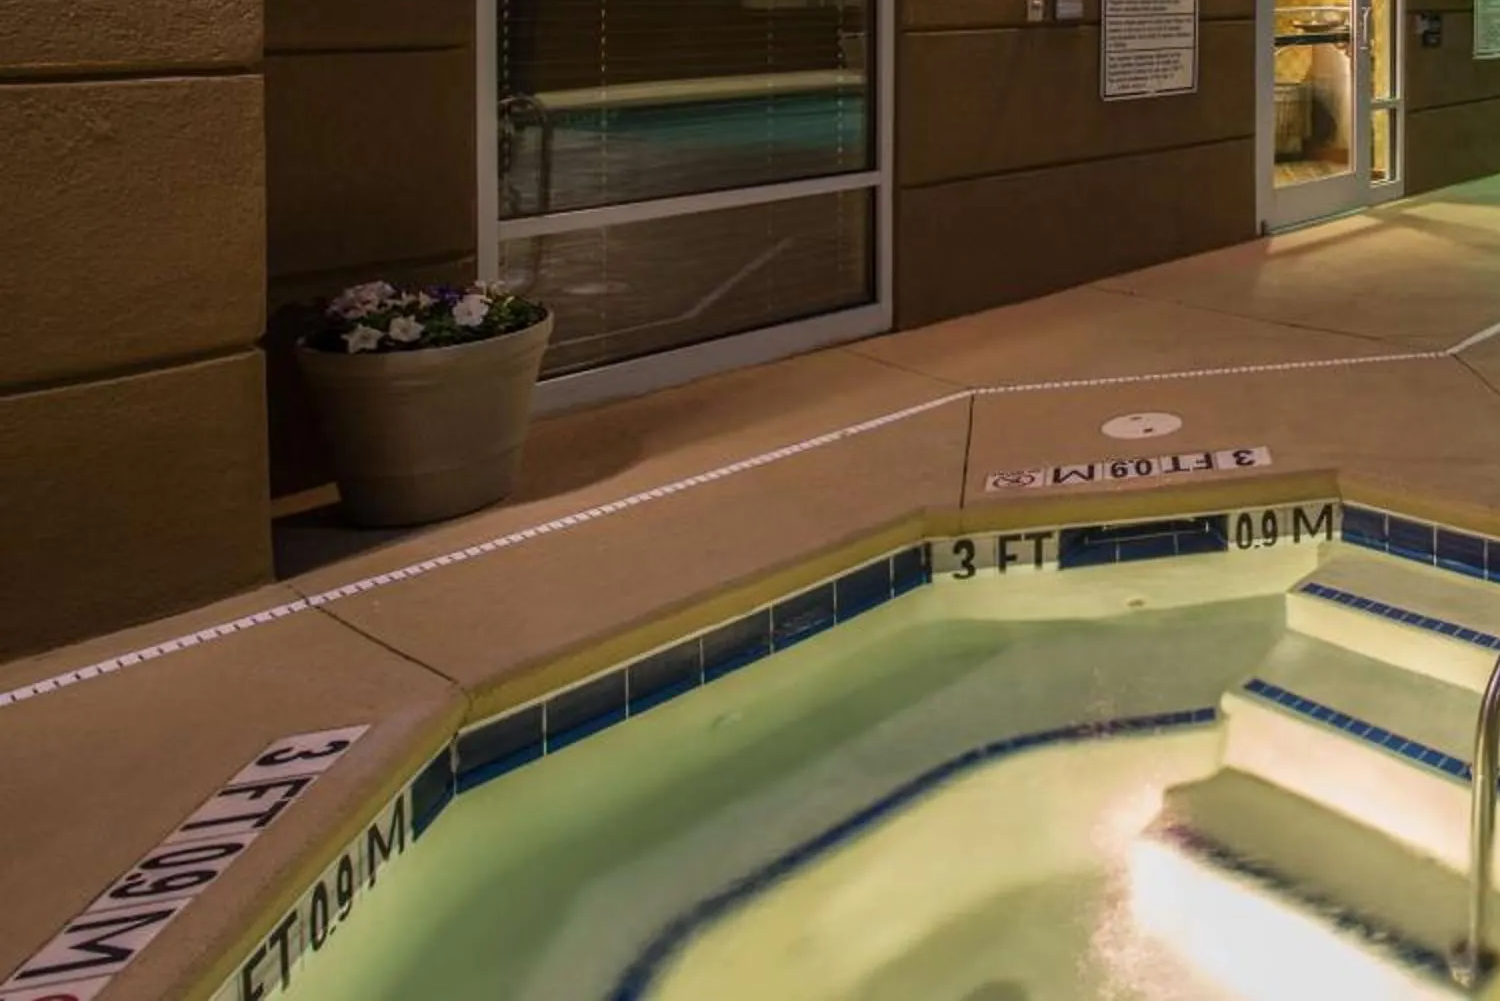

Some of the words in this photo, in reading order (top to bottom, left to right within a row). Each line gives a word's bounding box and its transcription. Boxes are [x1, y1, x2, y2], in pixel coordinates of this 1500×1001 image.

[1053, 465, 1095, 484] M
[1165, 452, 1214, 474] FT
[1233, 450, 1255, 466] 3
[952, 539, 976, 579] 3
[999, 531, 1053, 573] FT
[1235, 509, 1278, 550] 0.9
[1293, 504, 1334, 544] M
[256, 740, 351, 767] 3
[180, 775, 314, 832] FT
[109, 842, 245, 900] 0.9
[310, 854, 355, 952] 0.9
[366, 791, 406, 889] M
[14, 907, 178, 981] M
